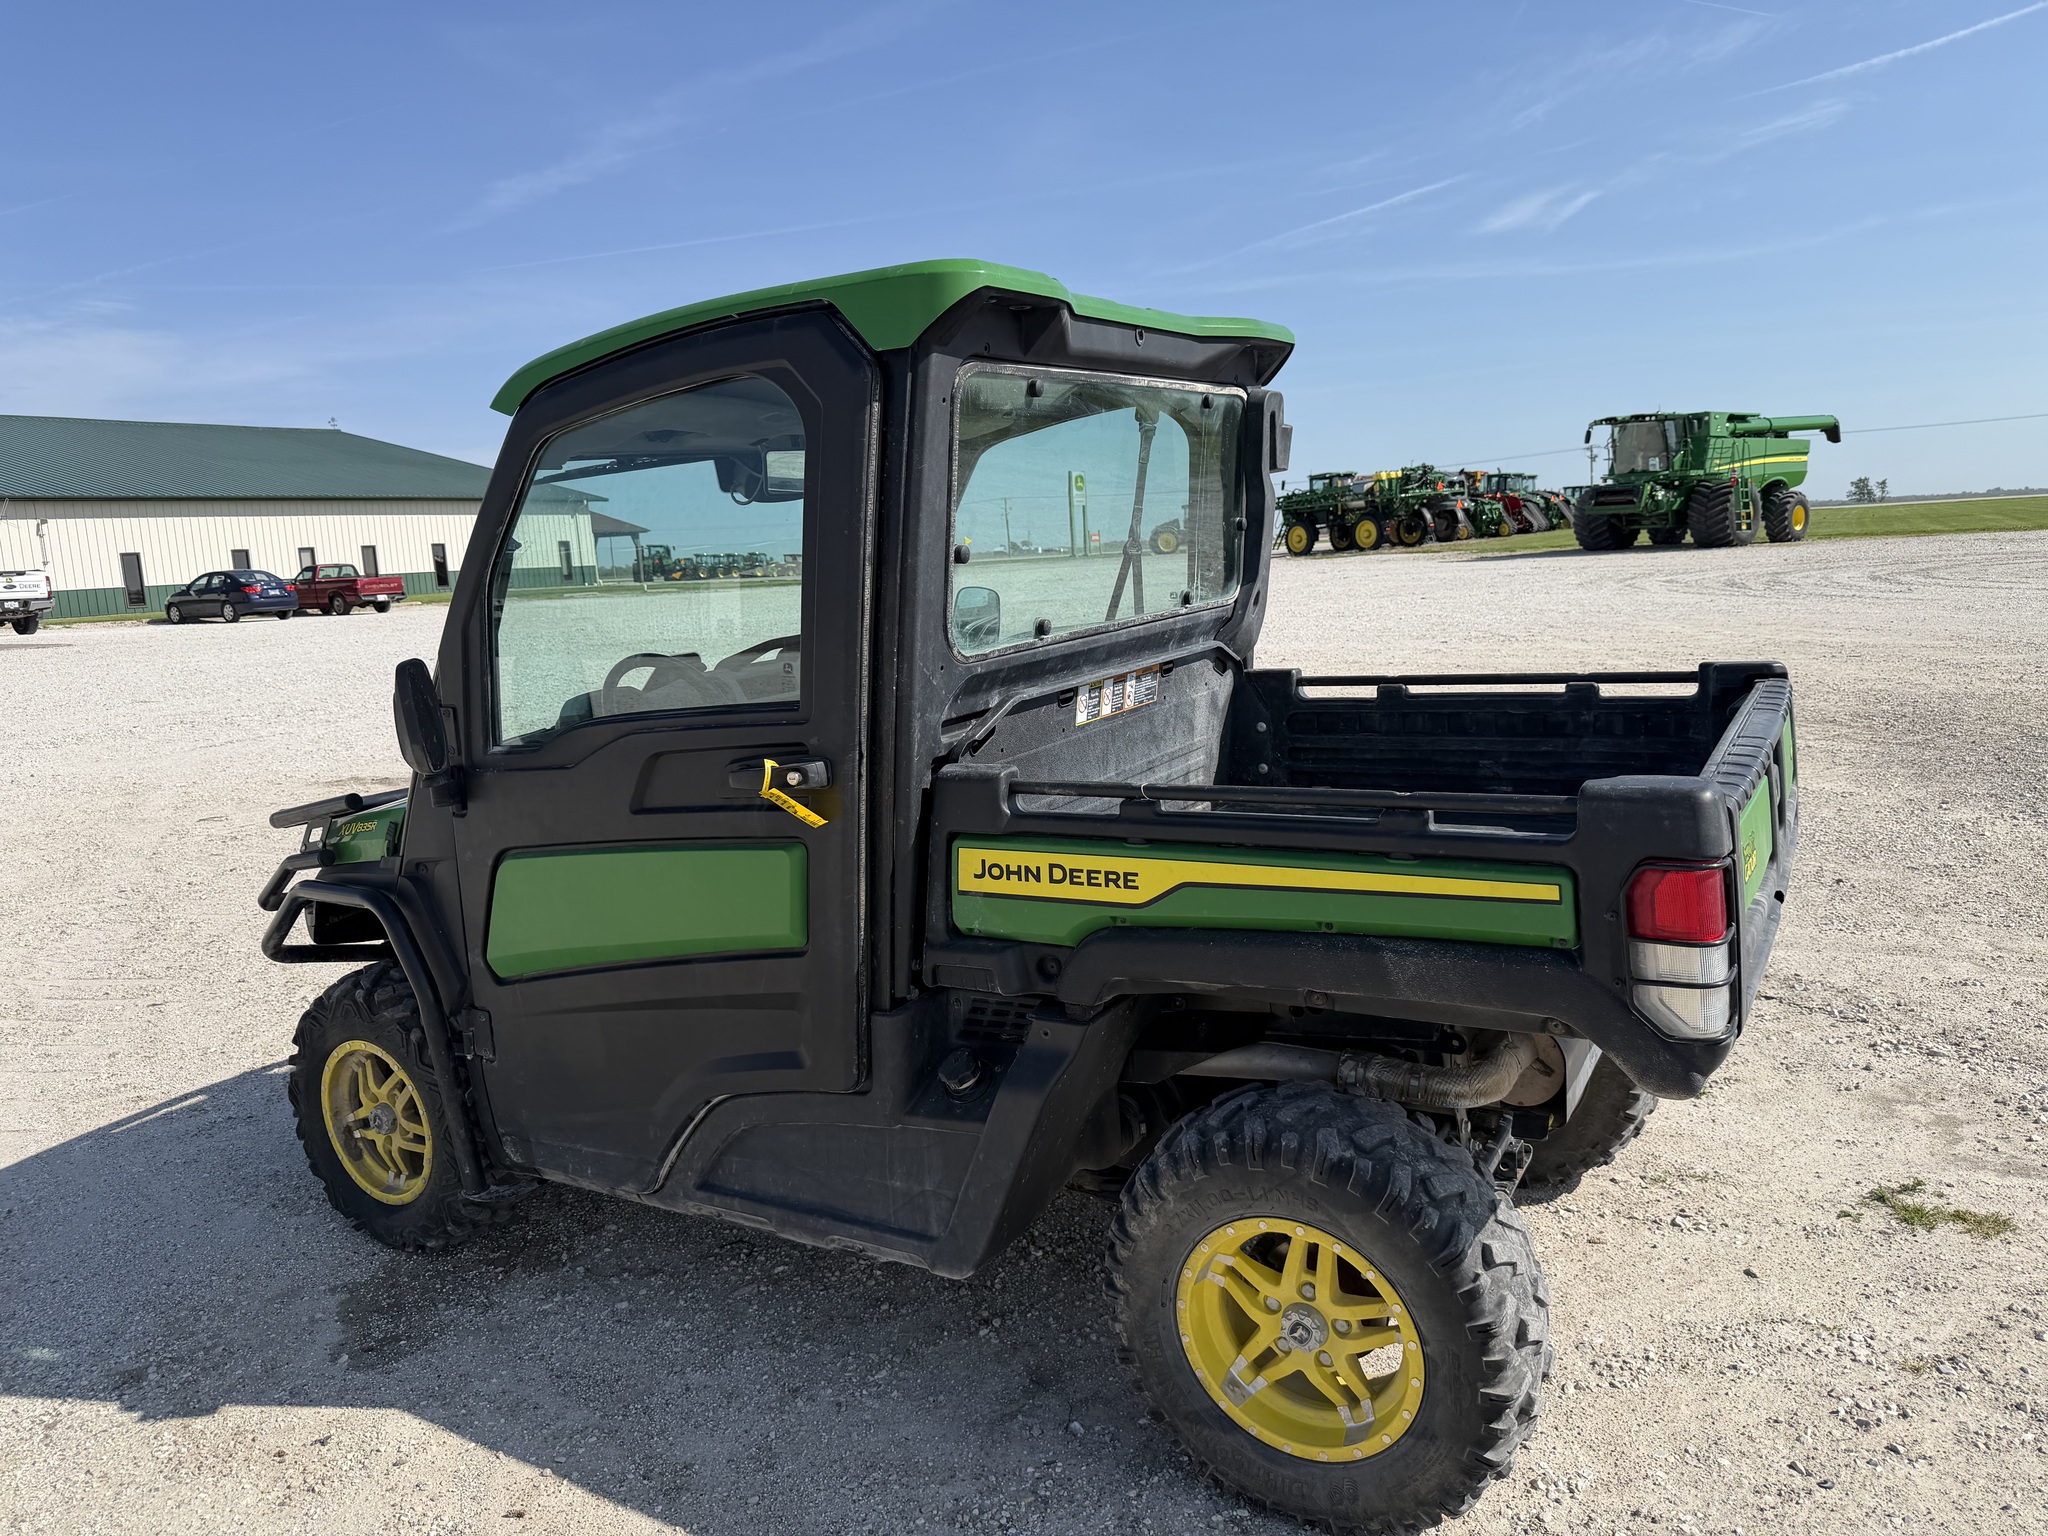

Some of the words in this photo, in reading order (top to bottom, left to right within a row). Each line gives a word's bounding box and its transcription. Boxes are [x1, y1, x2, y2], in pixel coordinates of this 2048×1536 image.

[339, 821, 378, 836] XUV835R
[973, 858, 1041, 883] JOHN
[1048, 863, 1140, 890] DEERE
